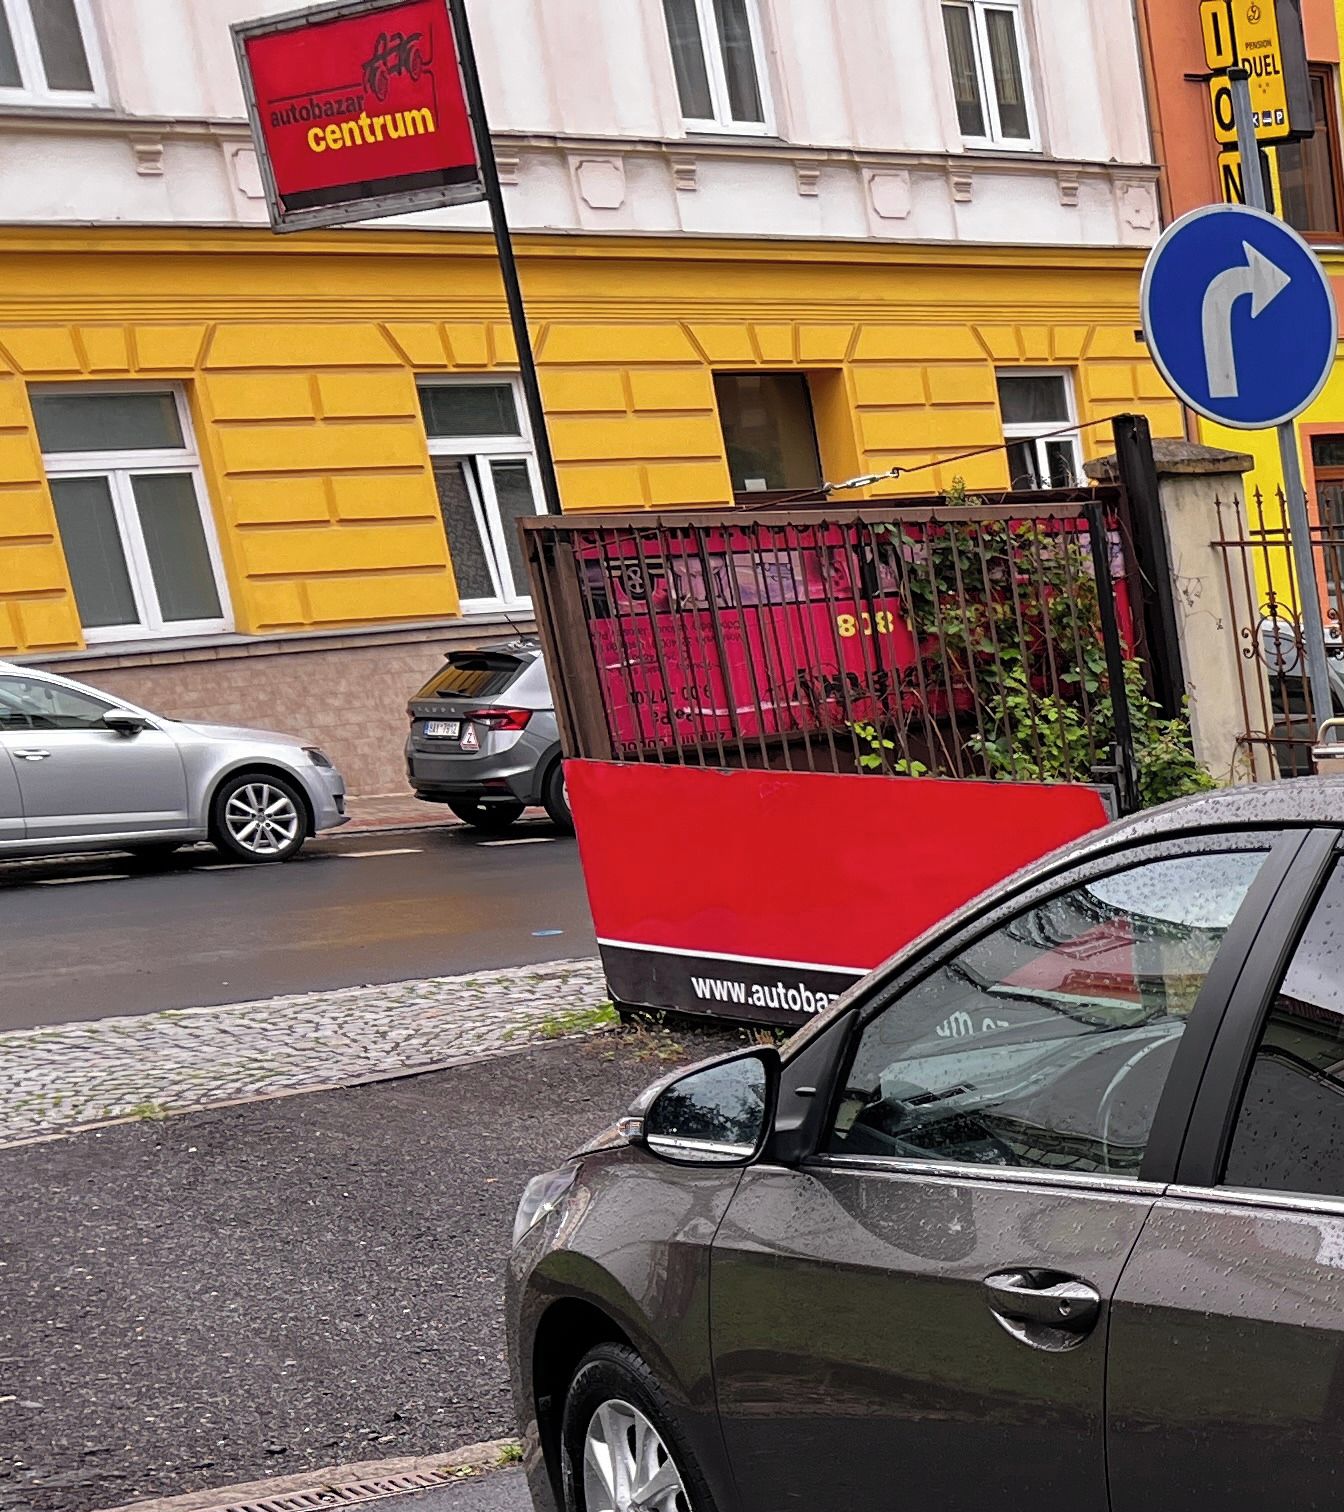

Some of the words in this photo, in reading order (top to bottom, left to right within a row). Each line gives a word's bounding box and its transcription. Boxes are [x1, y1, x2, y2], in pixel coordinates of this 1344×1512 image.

[1245, 39, 1272, 50] PENSION
[1241, 53, 1281, 78] DUEL
[271, 95, 365, 127] autobazar
[308, 107, 436, 152] centrum
